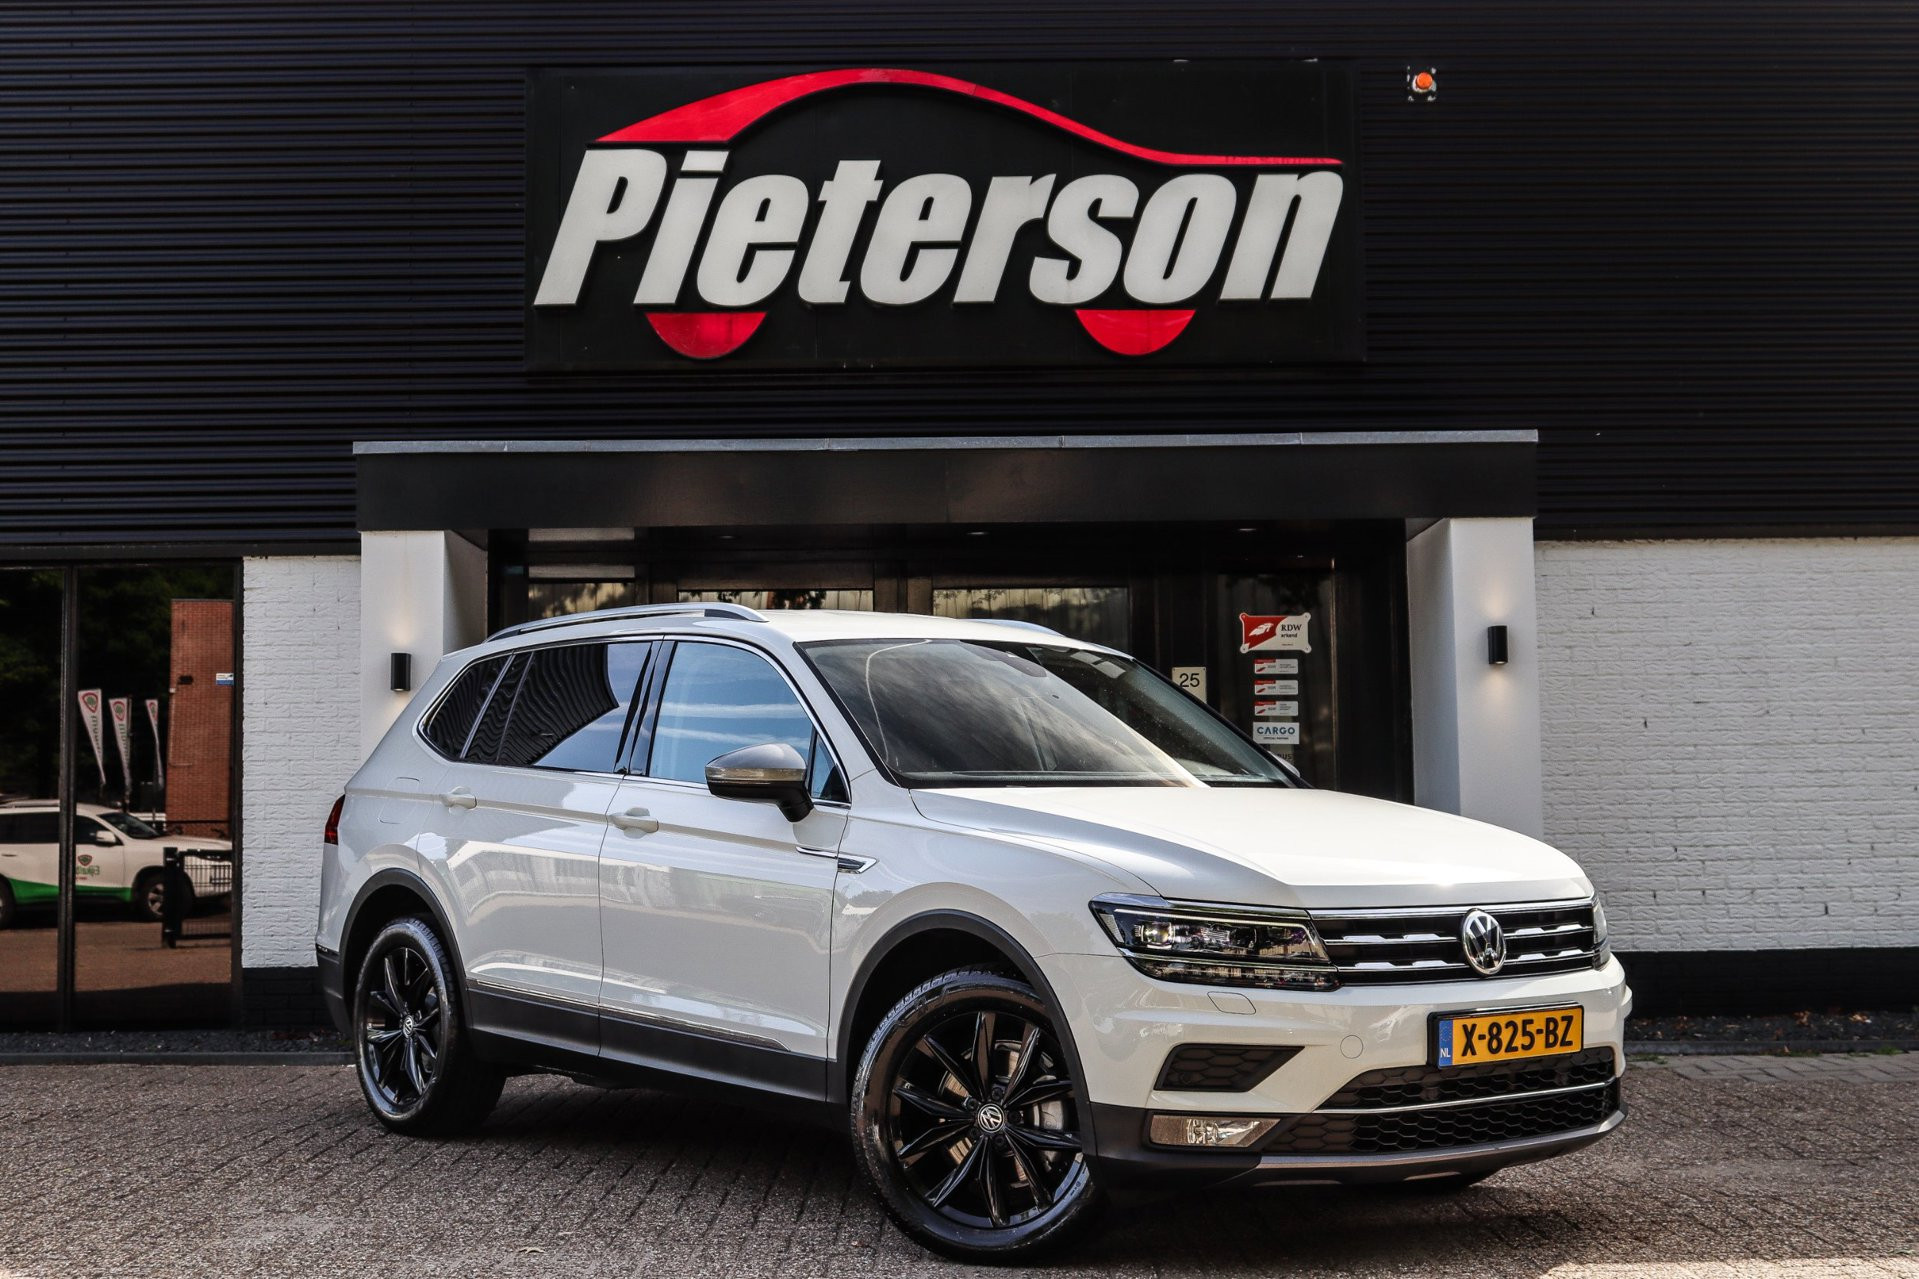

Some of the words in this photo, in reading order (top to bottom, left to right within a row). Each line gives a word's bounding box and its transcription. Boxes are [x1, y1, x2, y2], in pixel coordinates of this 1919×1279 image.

[533, 148, 1345, 307] Pieterson
[1281, 623, 1302, 632] RDW
[1179, 673, 1200, 688] 25
[1256, 726, 1296, 735] CARGO
[1461, 1015, 1574, 1057] X-825-BZ
[1440, 1047, 1451, 1058] NL
